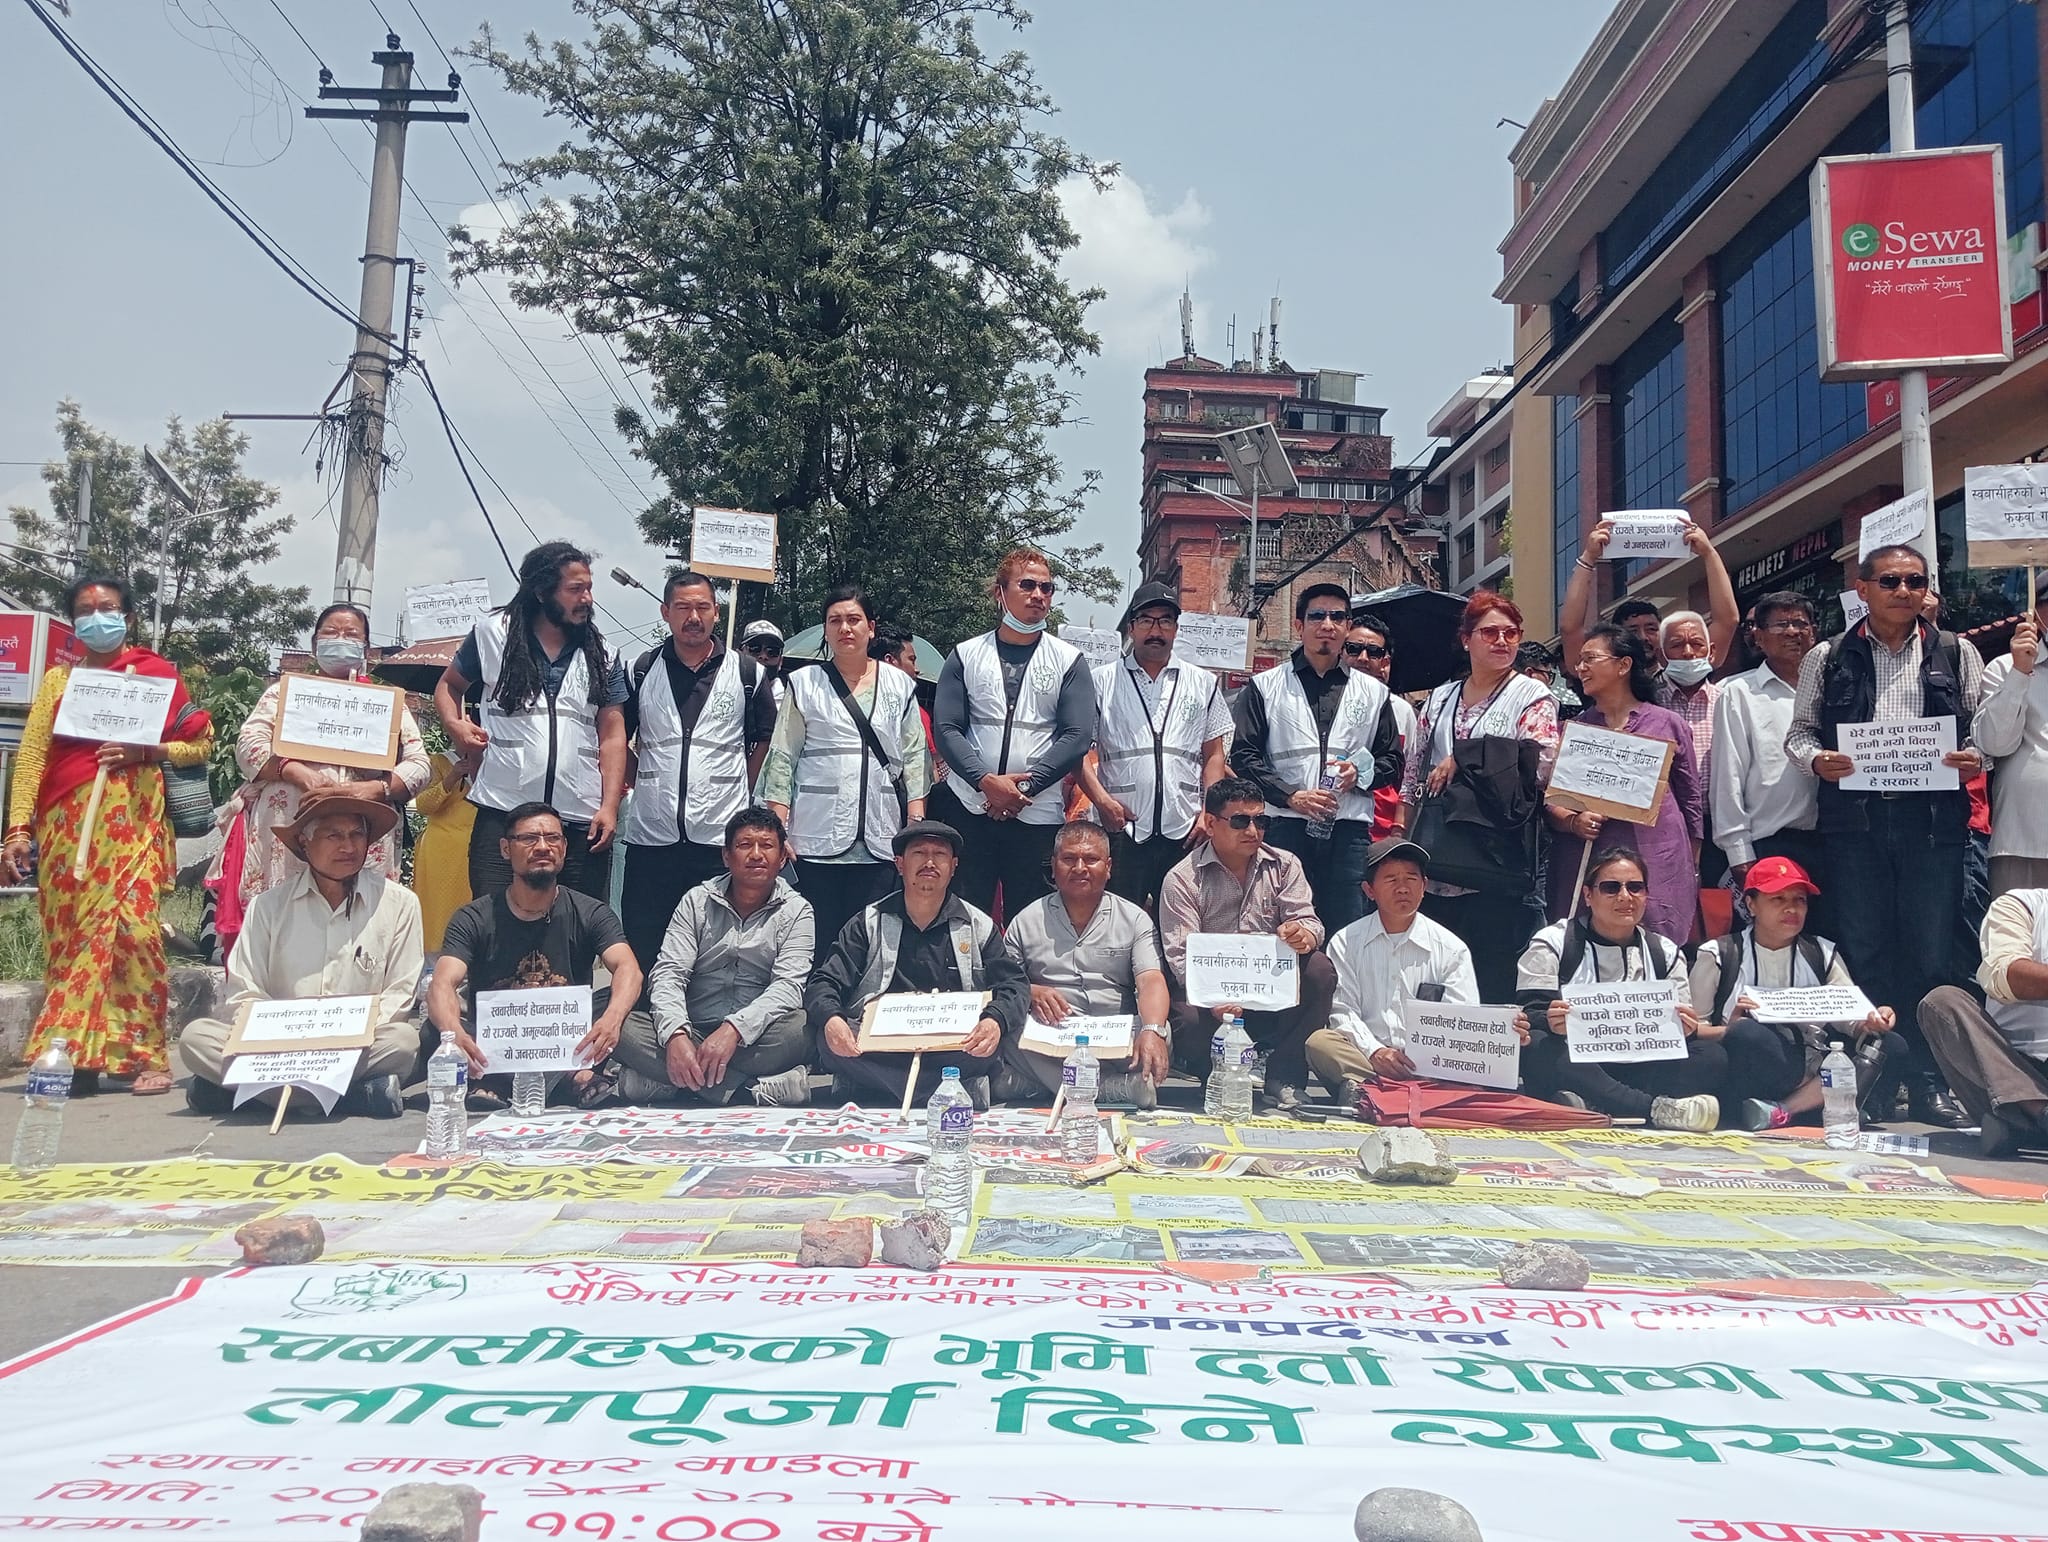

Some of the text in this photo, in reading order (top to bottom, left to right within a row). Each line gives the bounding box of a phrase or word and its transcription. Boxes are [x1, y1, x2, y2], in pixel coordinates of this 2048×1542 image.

[1847, 255, 1978, 272] MONEY TRANSFER
[1739, 529, 1828, 589] HELMETS NEPAL
[1882, 777, 1920, 787] सरकार
[1574, 1037, 1681, 1053] सरकारको अधिकार
[1173, 1300, 1275, 1314] हक
[932, 1331, 1156, 1382] भूमि
[990, 1386, 1318, 1445] दिने
[344, 1455, 651, 1476] माइतिघर
[675, 1454, 919, 1478] मण्डला
[34, 1479, 235, 1502] मिति:
